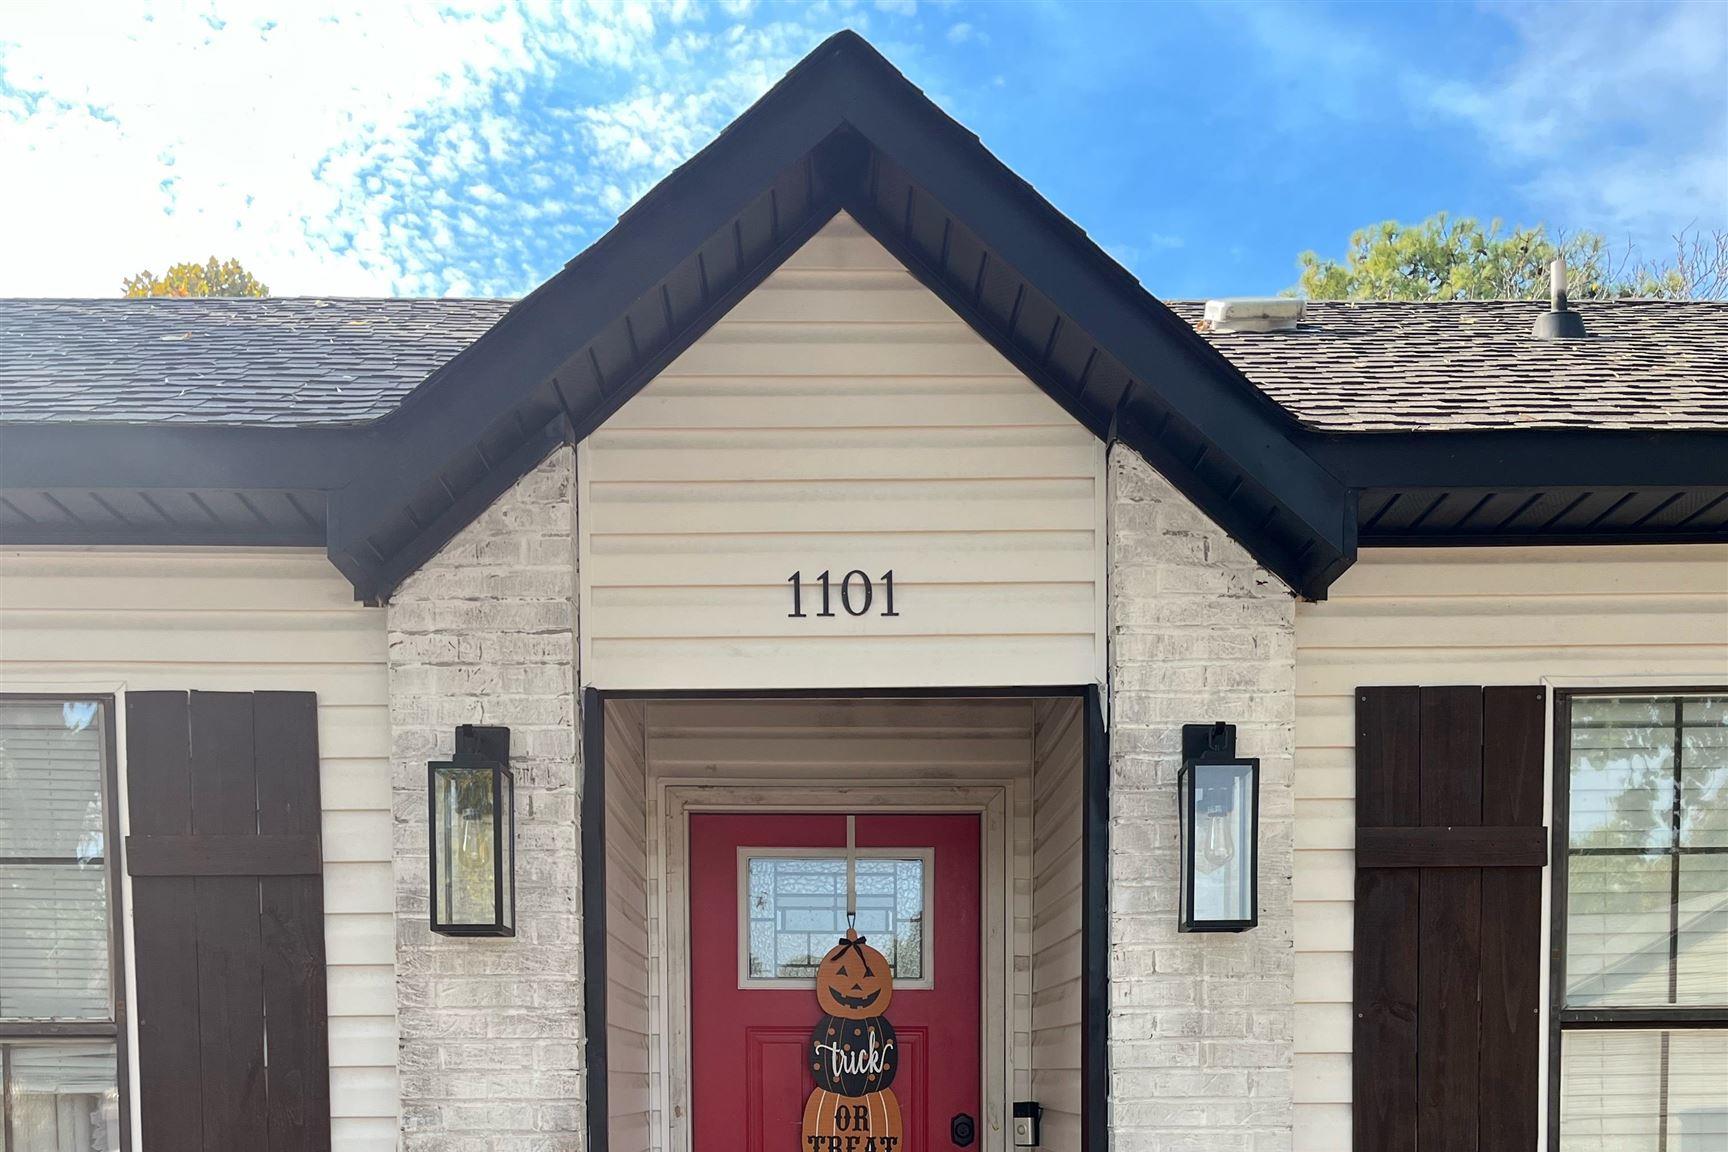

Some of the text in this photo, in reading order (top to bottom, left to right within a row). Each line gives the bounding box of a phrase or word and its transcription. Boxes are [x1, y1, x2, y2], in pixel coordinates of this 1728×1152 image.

[787, 569, 900, 618] 1101
[815, 1030, 894, 1077] trick
[834, 1105, 870, 1132] OR
